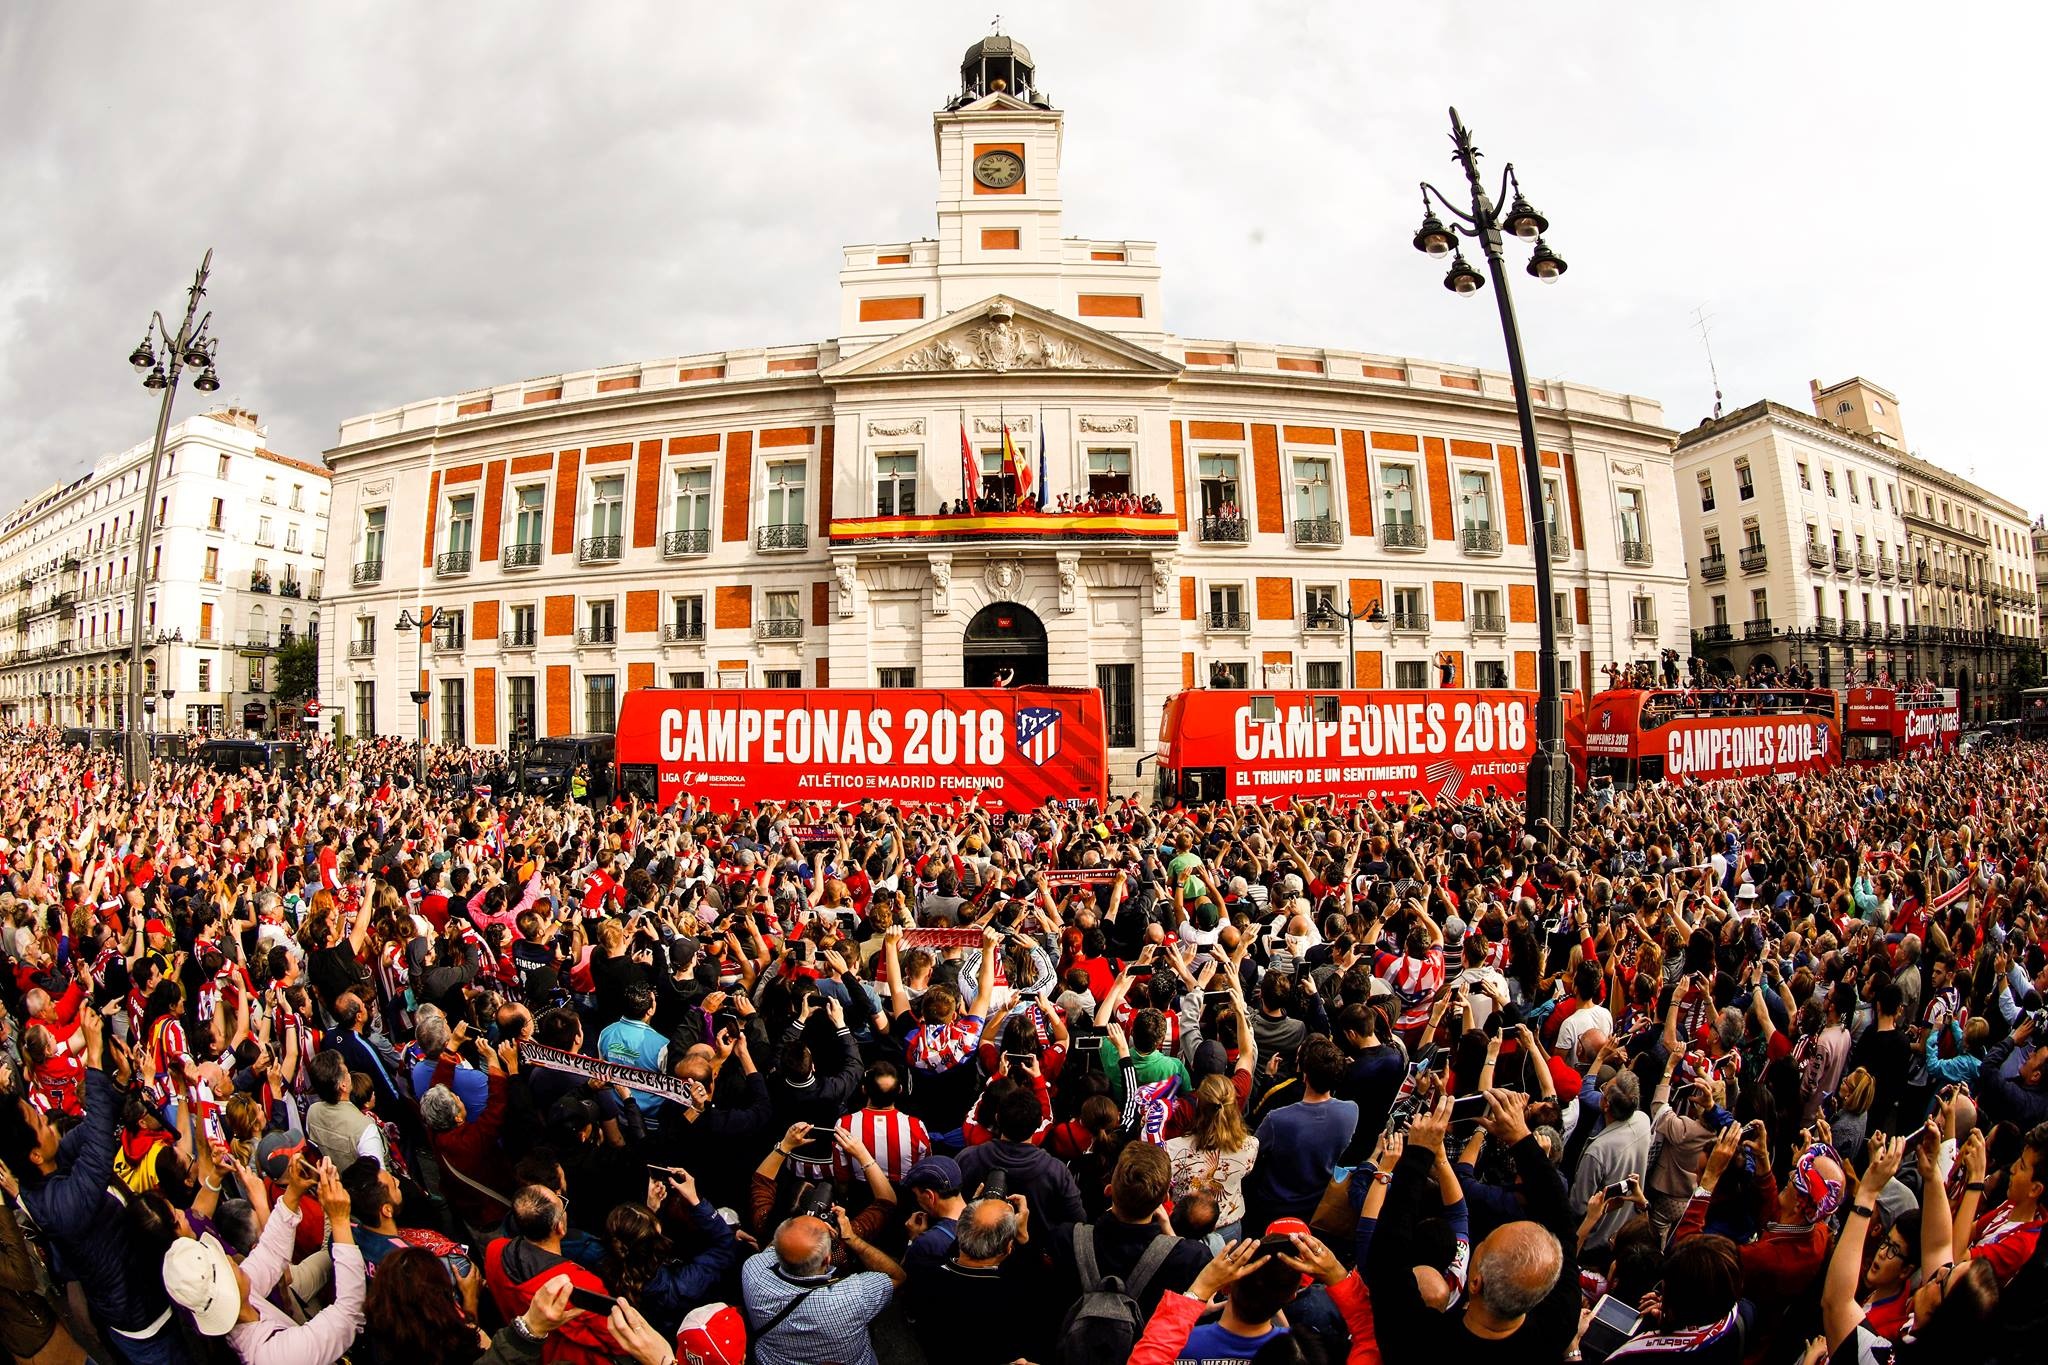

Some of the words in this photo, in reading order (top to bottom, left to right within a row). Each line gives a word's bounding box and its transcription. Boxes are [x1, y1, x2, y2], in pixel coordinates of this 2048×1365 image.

[659, 708, 893, 765] CAMPEONAS
[903, 708, 1005, 765] 2018
[1235, 702, 1447, 761] CAMPEONES
[1454, 701, 1527, 753] 2018
[1905, 707, 1959, 744] ¡Campenas!
[1586, 733, 1616, 746] CAMPEONES
[1615, 734, 1629, 746] 2018
[1668, 725, 1775, 775] CAMPEONES
[1777, 723, 1812, 764] 2018
[661, 772, 680, 783] LIGA
[709, 775, 746, 783] IBERDROLA
[1235, 770, 1251, 786] EL
[1252, 768, 1303, 785] TRIUNFO
[1306, 768, 1322, 783] DE
[1324, 767, 1341, 783] UN
[1343, 764, 1417, 782] SENTIMIENTO
[1470, 761, 1517, 776] ATLÉTICO
[1518, 763, 1526, 772] DE
[798, 772, 864, 788] ATLÉTICO
[866, 777, 876, 786] DE
[878, 775, 936, 789] MADRID
[939, 775, 1004, 789] FEMENINO
[573, 1057, 608, 1076] PERO
[610, 1064, 693, 1100] PRESENTES
